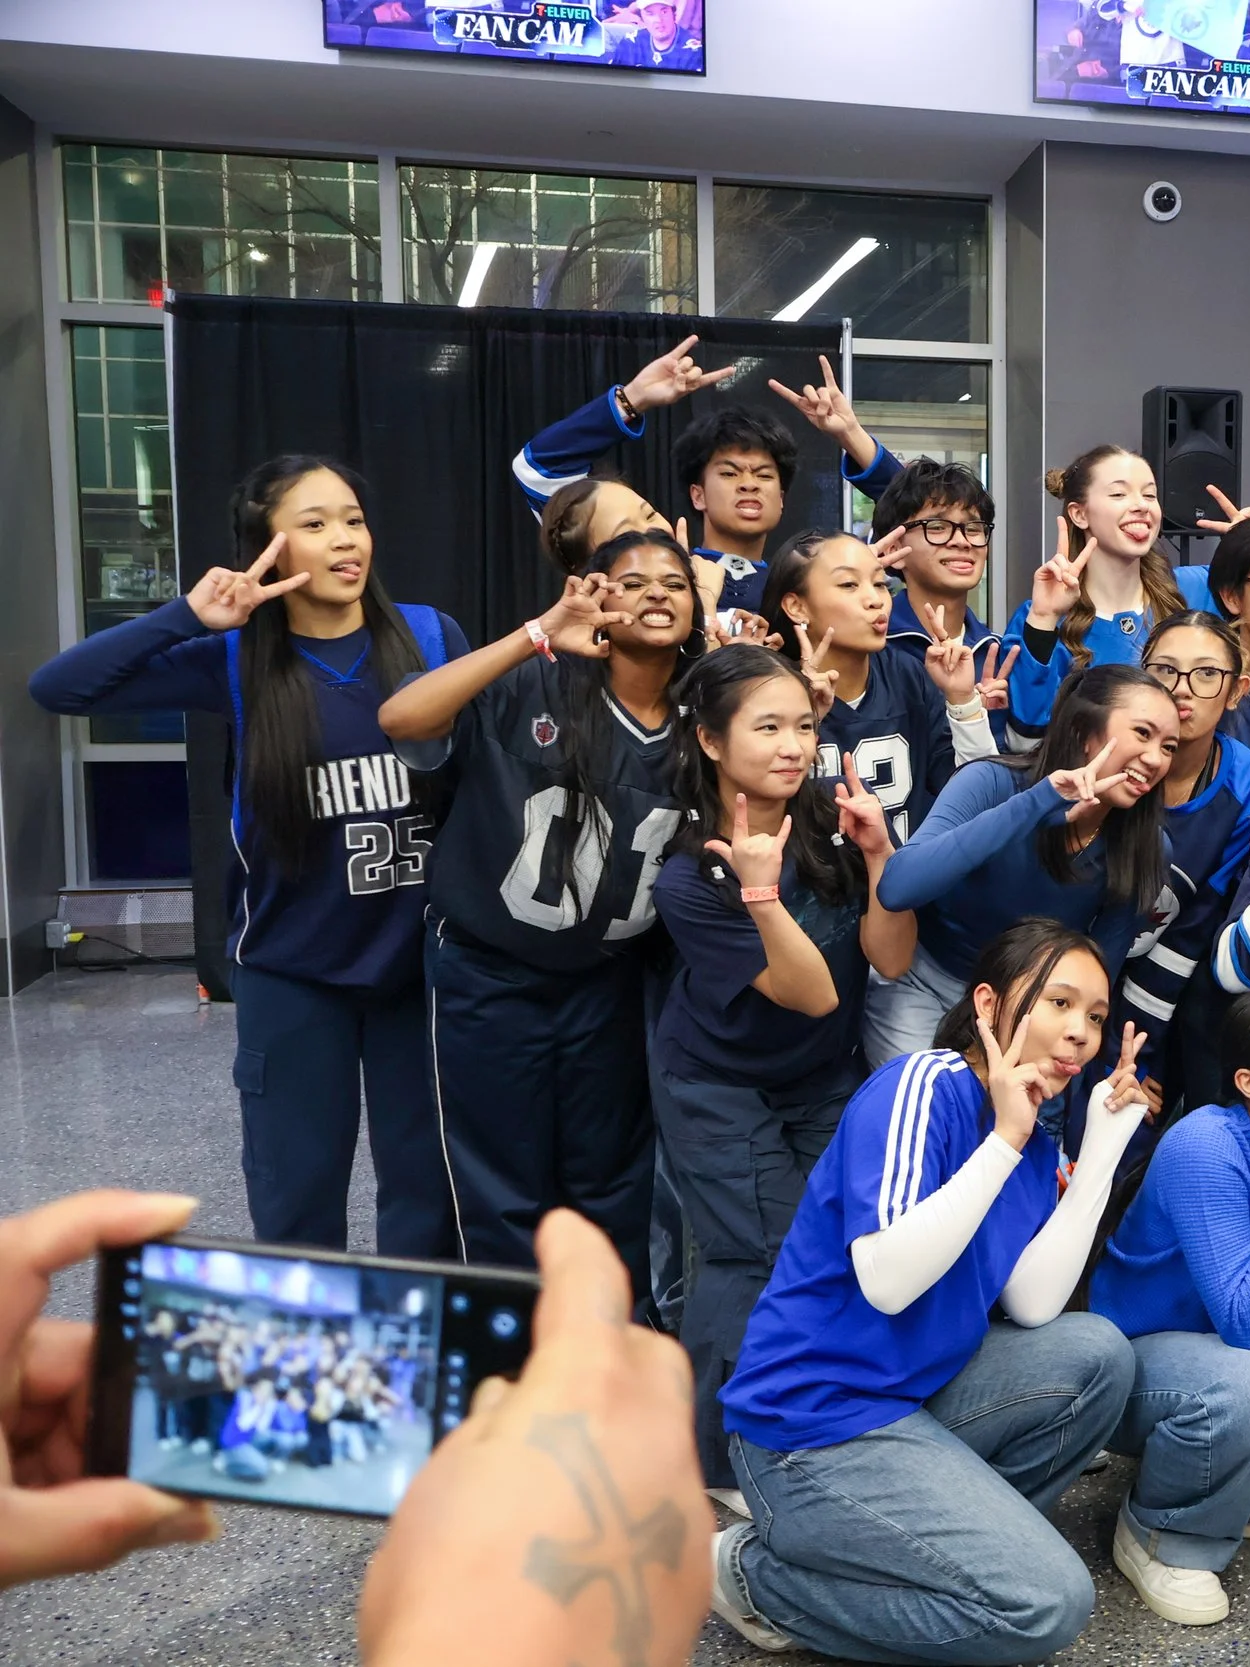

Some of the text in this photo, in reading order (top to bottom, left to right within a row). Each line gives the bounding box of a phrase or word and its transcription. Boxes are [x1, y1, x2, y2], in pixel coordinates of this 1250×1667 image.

[453, 13, 587, 47] FAN CAM
[1143, 69, 1196, 96] FAN
[345, 814, 436, 896] 25
[499, 784, 682, 941] 01
